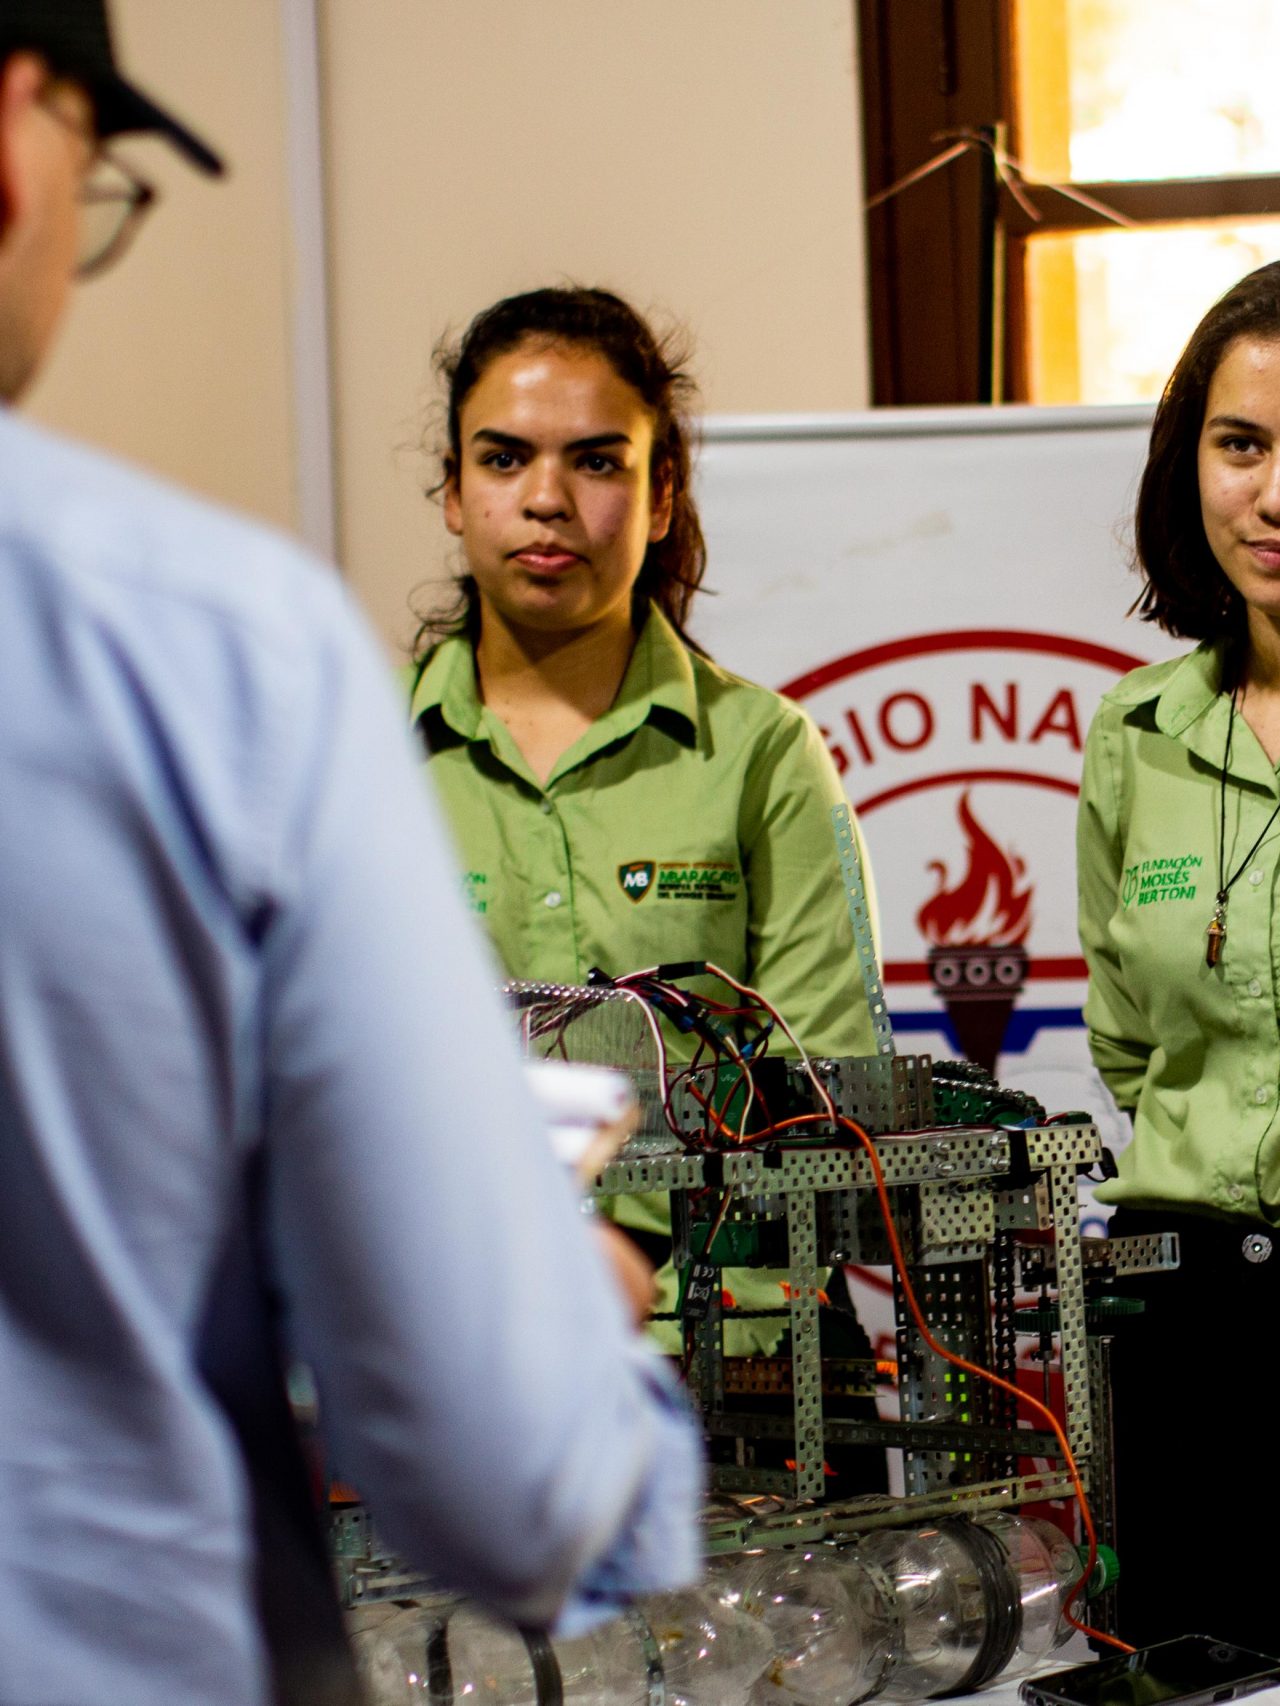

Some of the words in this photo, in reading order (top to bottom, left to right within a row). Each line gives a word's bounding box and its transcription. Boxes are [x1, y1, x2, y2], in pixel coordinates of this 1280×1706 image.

[1141, 854, 1203, 874] FUNDACIÓN
[623, 870, 649, 889] MB
[1140, 871, 1190, 889] MOISÉS
[1138, 886, 1196, 906] BERTONI
